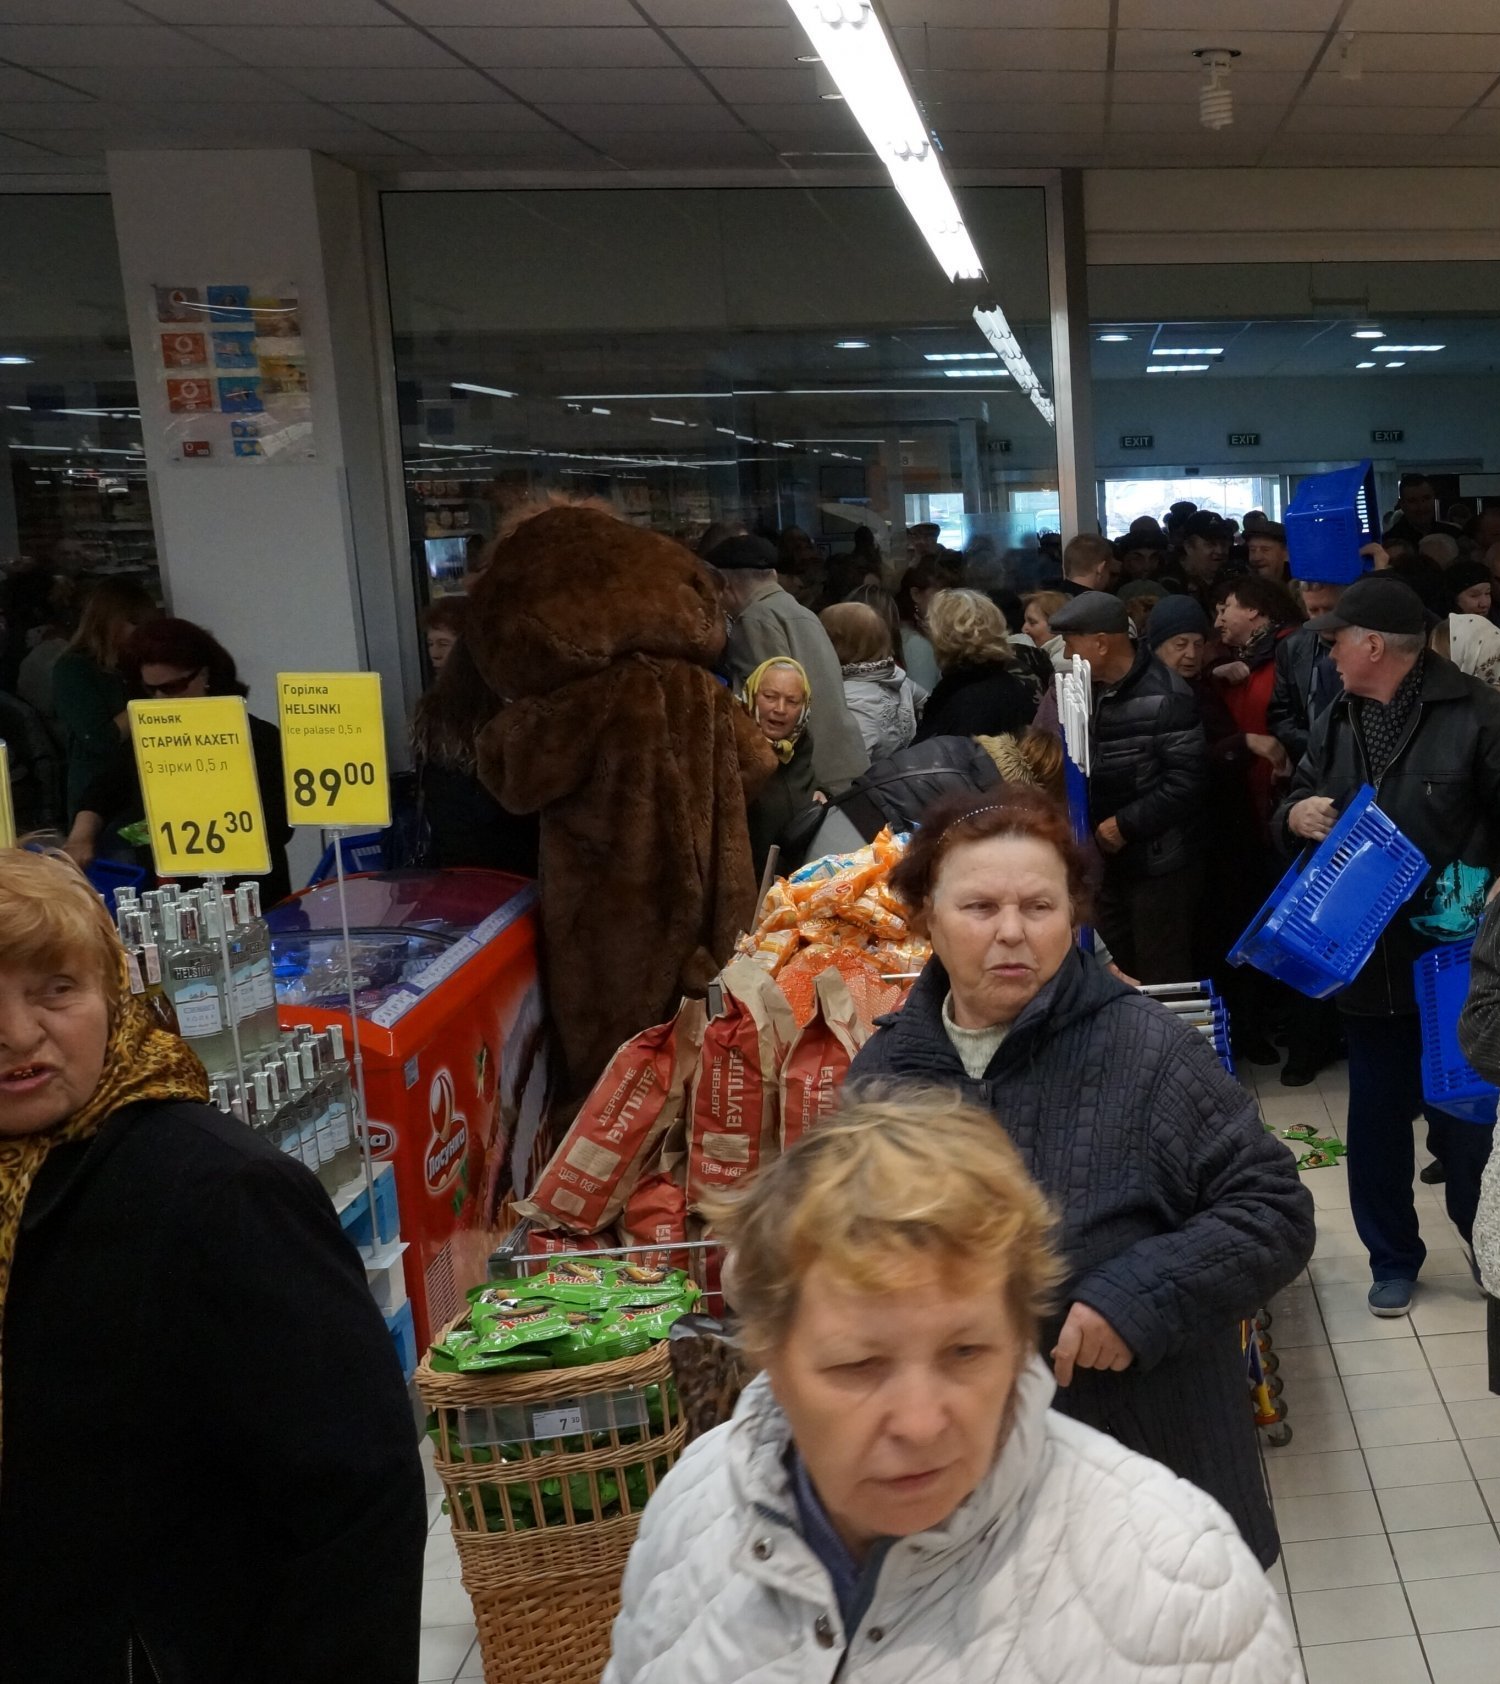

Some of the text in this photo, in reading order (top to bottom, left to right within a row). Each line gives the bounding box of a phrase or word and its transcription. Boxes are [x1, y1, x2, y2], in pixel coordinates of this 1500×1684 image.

[1124, 437, 1150, 447] EXIT
[1231, 435, 1256, 445] EXIT
[1375, 431, 1400, 441] EXIT
[283, 684, 329, 696] Горілка
[285, 704, 341, 714] HELSINKI
[138, 713, 182, 725] Коньяк
[287, 726, 301, 734] Ice
[303, 725, 335, 736] palase
[338, 725, 354, 735] 0,5
[141, 733, 240, 748] СТАРИЙ КАХЕТІ
[145, 758, 228, 776] 3 зірки 0,5 л
[711, 1055, 722, 1117] ДЕРЕВНЕ
[598, 1067, 637, 1126] ДЕРЕВНЕ
[560, 1418, 568, 1430] 7
